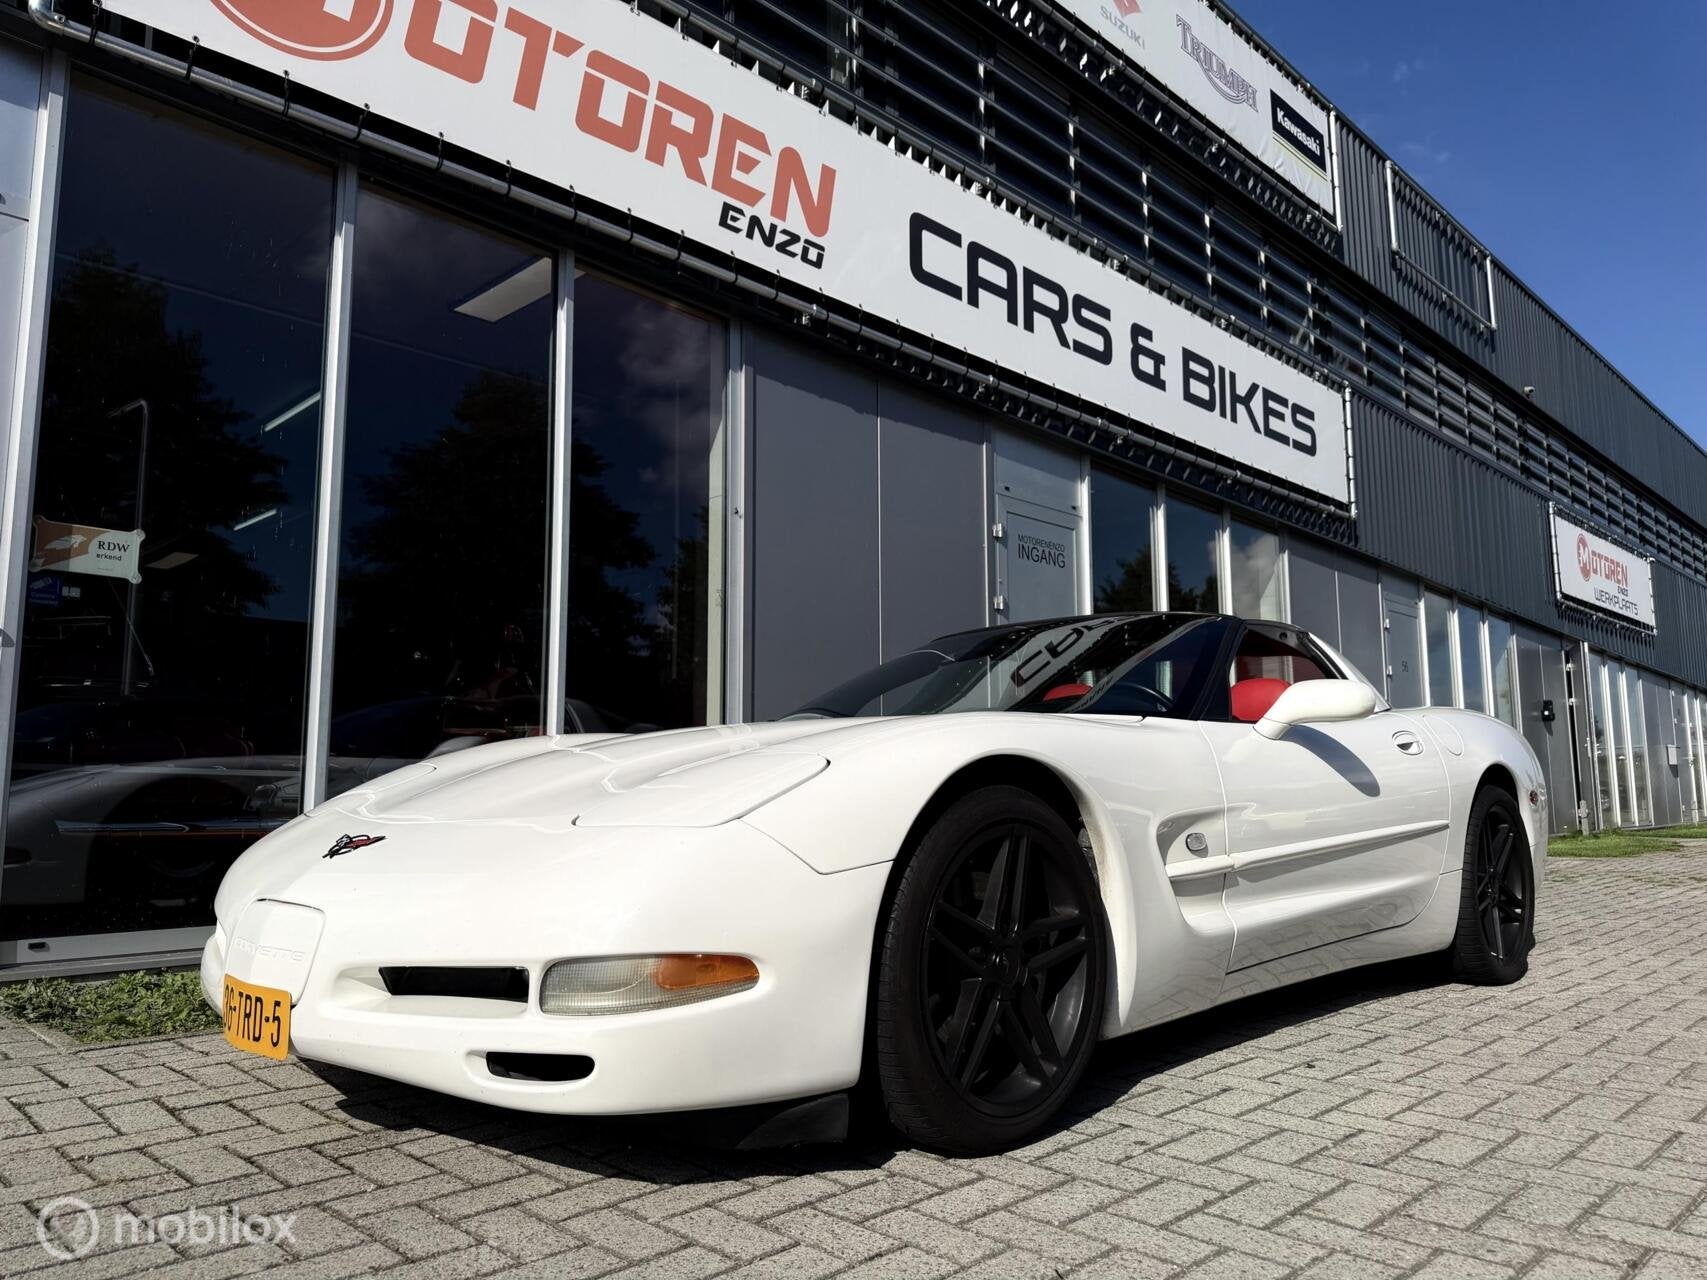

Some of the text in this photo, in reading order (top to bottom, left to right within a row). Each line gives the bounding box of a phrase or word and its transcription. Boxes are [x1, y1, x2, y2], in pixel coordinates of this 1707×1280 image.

[1100, 5, 1146, 50] SUZUKI
[1176, 14, 1258, 112] TRIUMPH
[320, 0, 836, 238] OTOREN
[1276, 106, 1321, 156] Kawasaki
[718, 201, 826, 270] ENZO
[909, 212, 1317, 457] CARS & BIKES
[96, 552, 123, 562] erkend
[97, 540, 130, 552] RDW
[1018, 543, 1066, 569] INGANG
[1577, 533, 1629, 588] MOTOREN
[1594, 586, 1639, 616] WERKPLAATS
